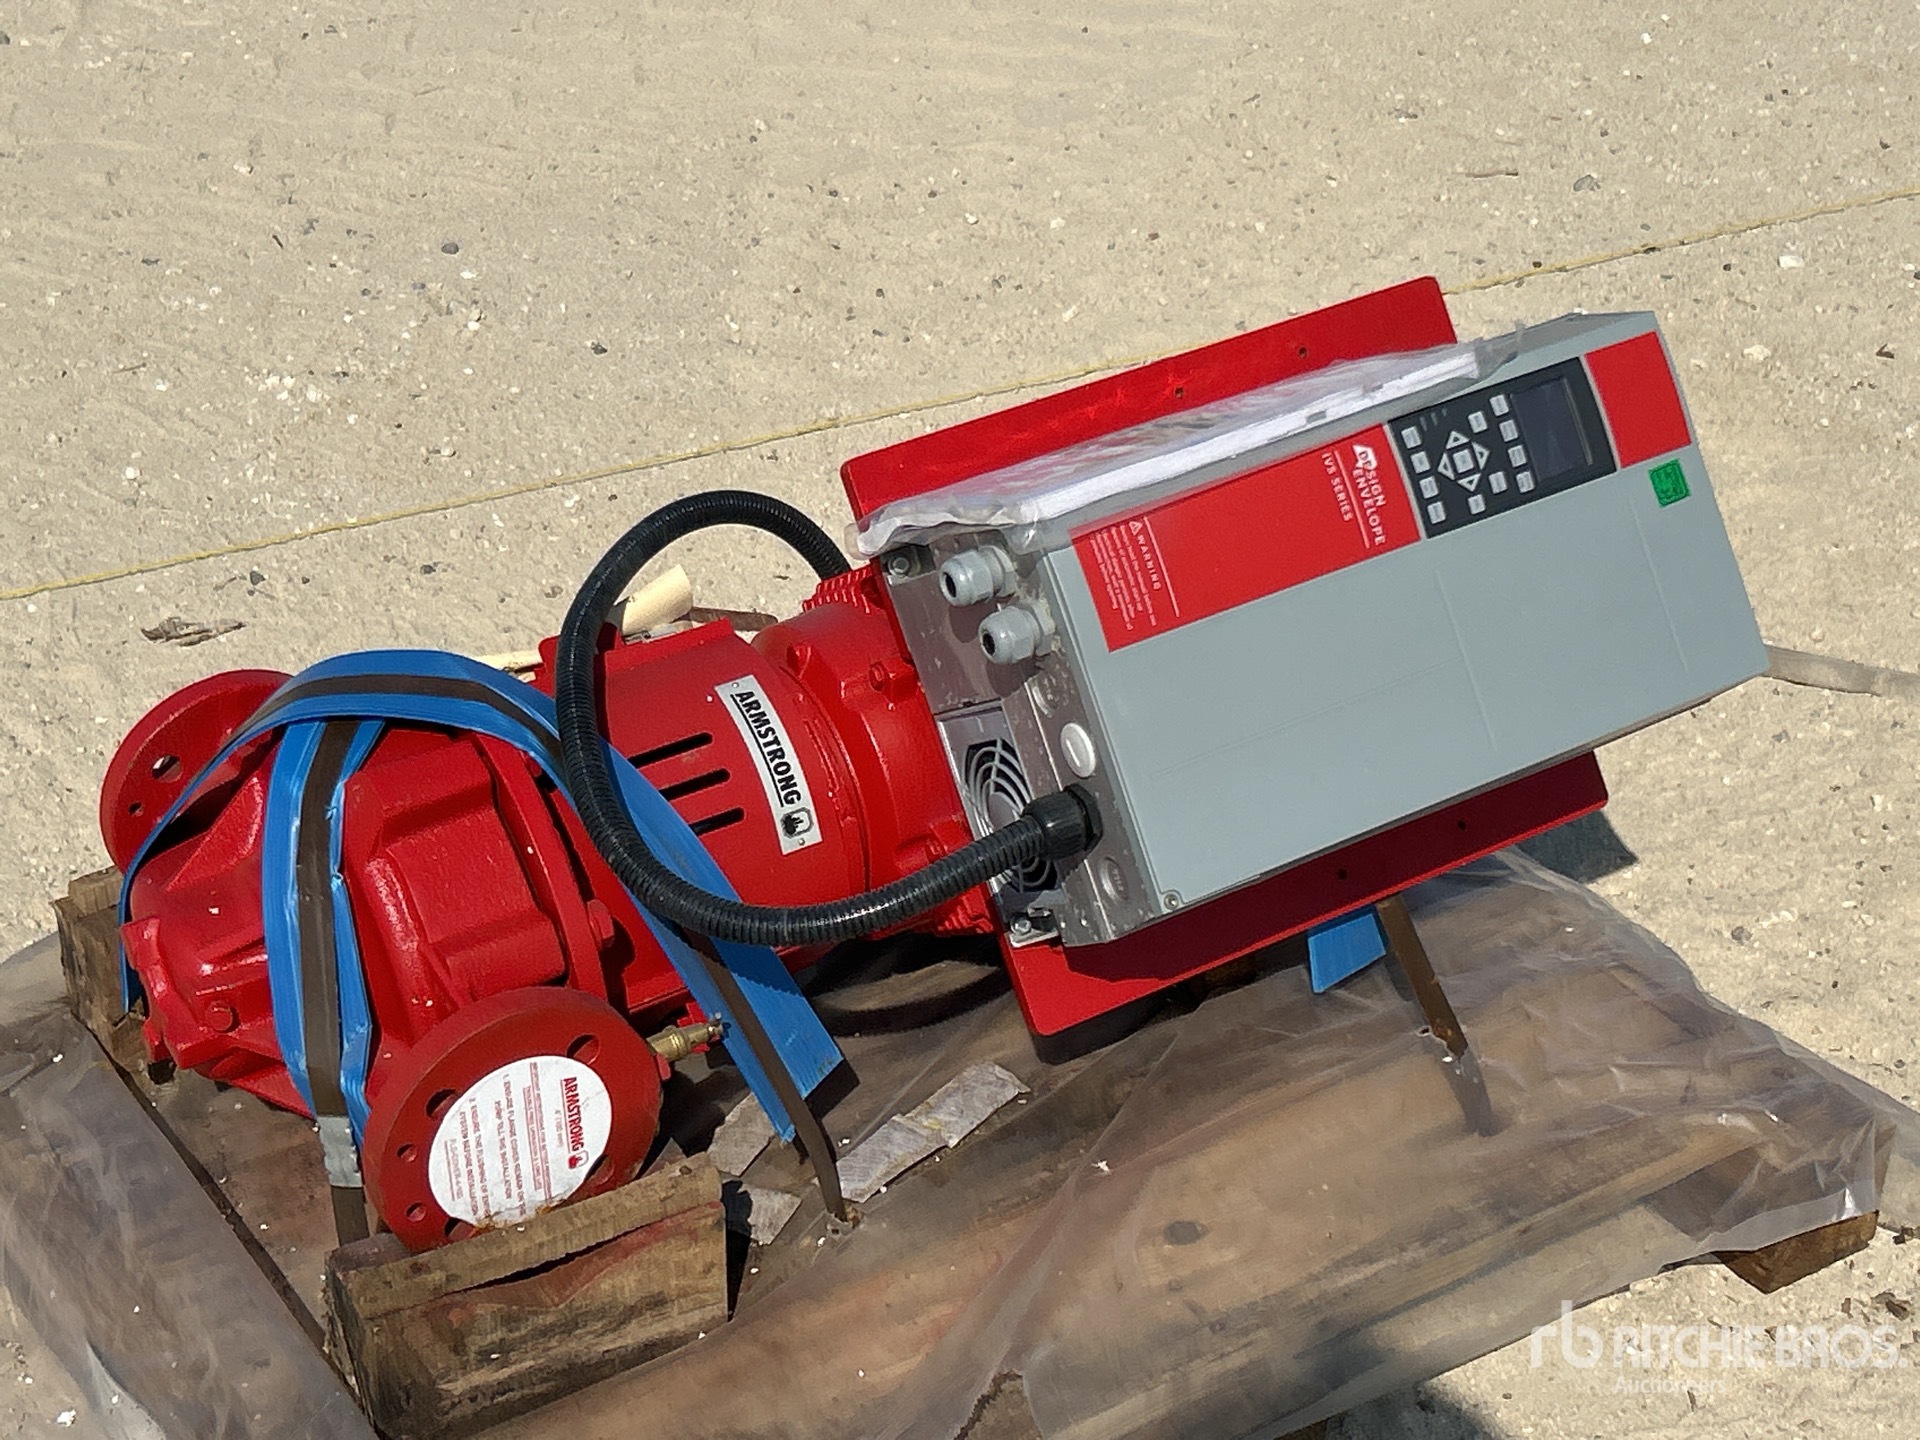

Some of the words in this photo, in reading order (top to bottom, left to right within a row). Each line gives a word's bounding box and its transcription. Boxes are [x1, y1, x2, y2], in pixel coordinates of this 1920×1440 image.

[1322, 452, 1337, 475] IVS
[1331, 477, 1353, 521] SERIES
[1352, 469, 1386, 545] ENVELOPE
[1359, 451, 1386, 506] DESIGN
[1138, 535, 1161, 590] WARNING
[735, 691, 801, 805] ARMSTRONG
[563, 1077, 585, 1151] ARMSTRONG
